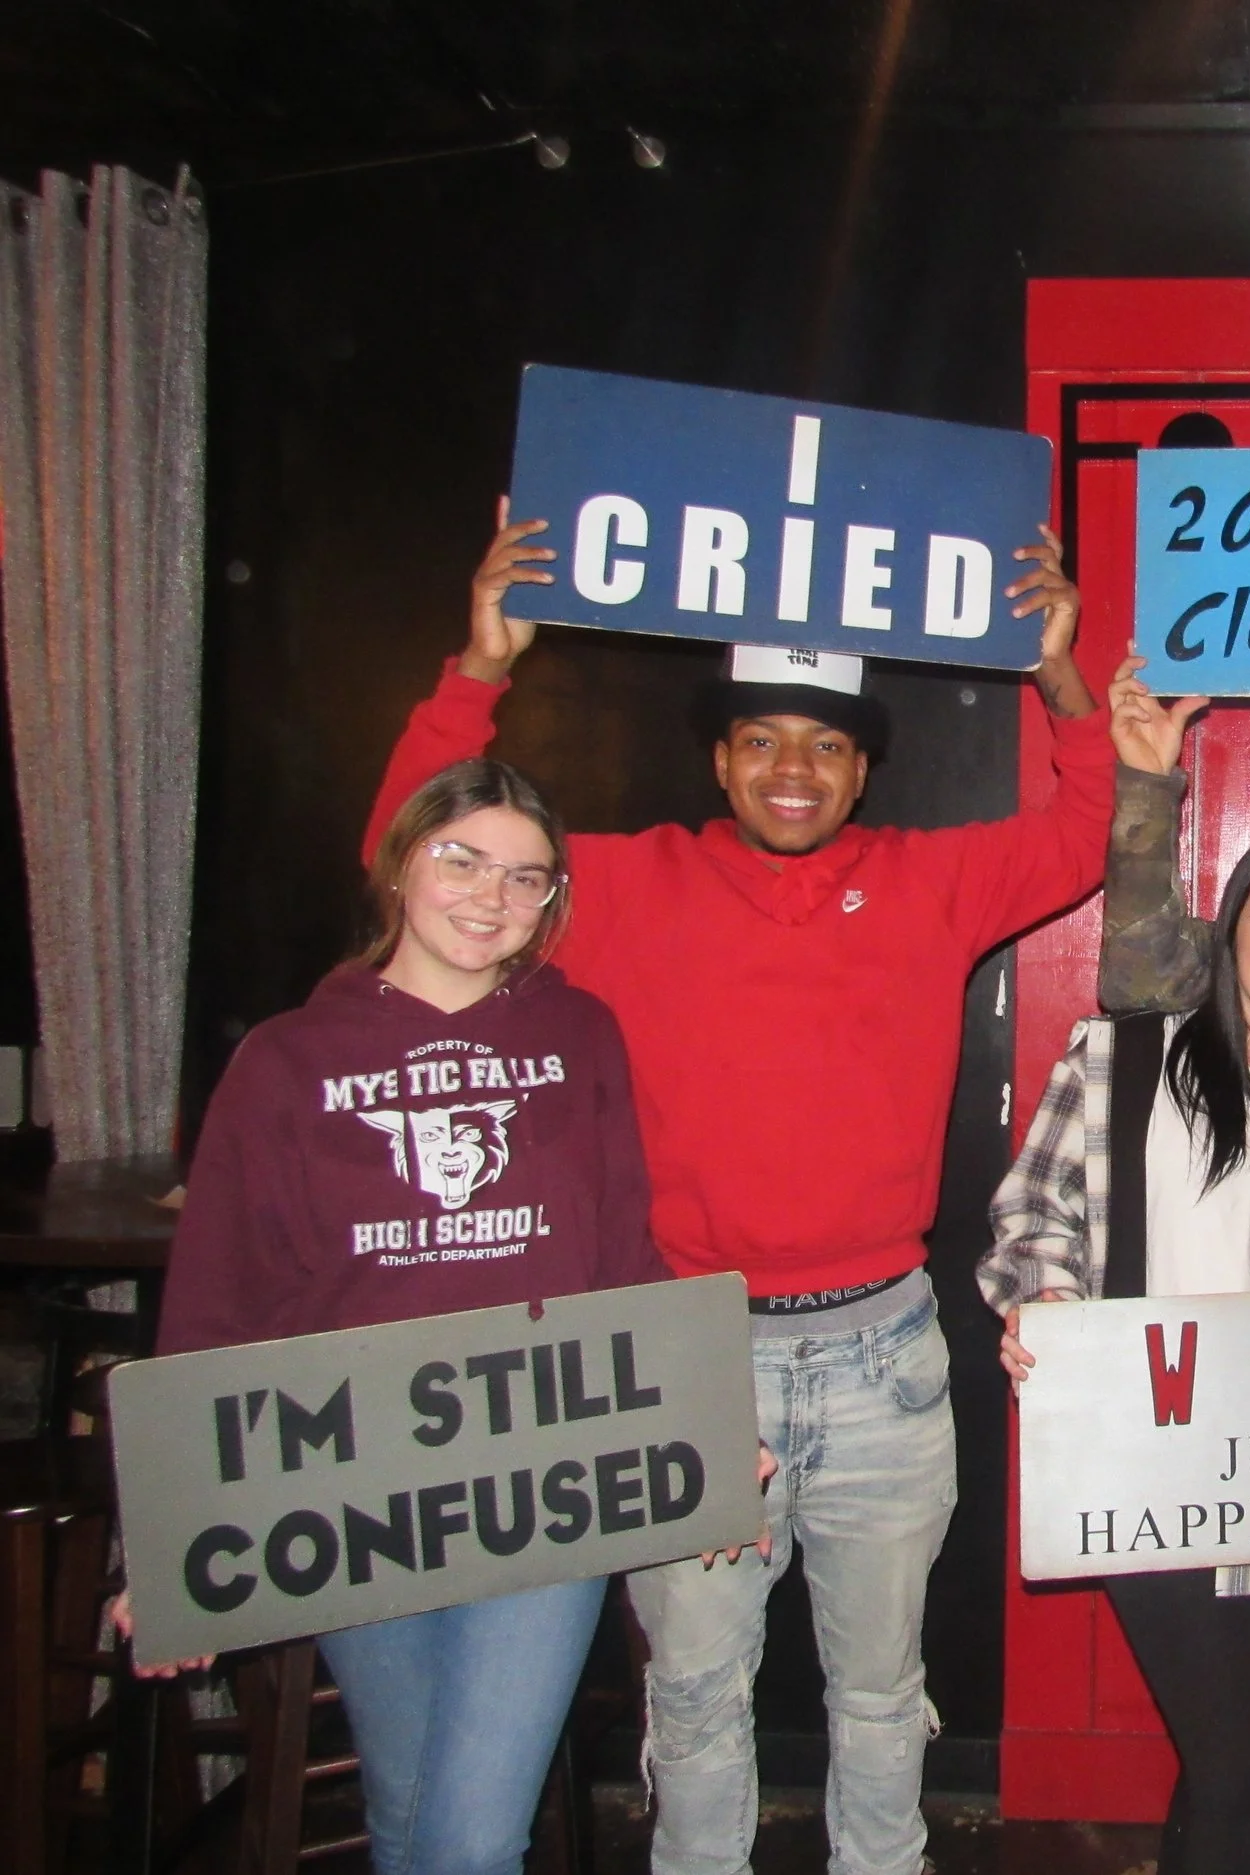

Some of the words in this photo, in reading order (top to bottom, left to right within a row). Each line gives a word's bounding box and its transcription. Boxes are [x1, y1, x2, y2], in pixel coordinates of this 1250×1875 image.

[788, 415, 821, 505] I
[573, 495, 993, 639] CRIED
[475, 1043, 494, 1056] OF
[378, 1250, 438, 1266] ATHLETIC
[441, 1243, 527, 1262] DEPARTMENT
[214, 1376, 357, 1484] I'M
[408, 1330, 662, 1447] STILL
[184, 1440, 706, 1613] CONFUSED
